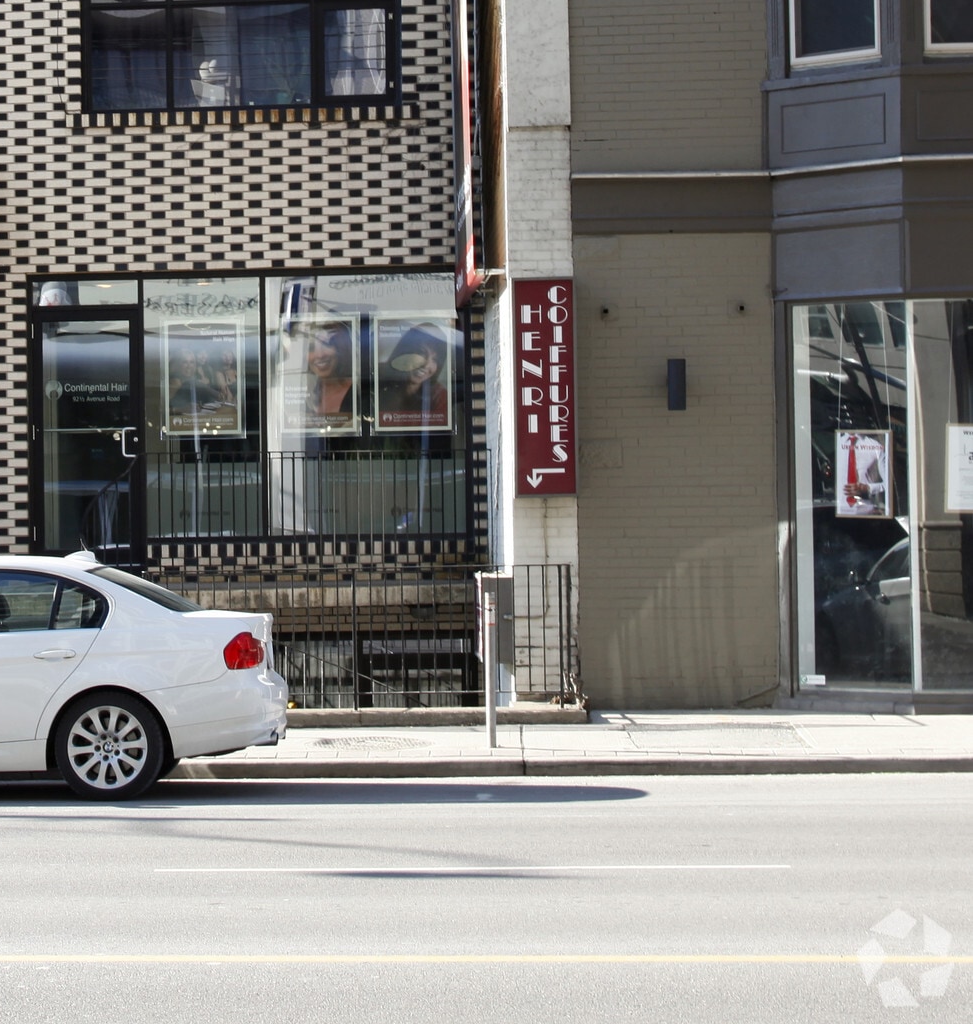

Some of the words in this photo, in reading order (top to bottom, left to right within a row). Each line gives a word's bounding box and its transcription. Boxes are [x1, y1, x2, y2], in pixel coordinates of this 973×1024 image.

[64, 383, 108, 393] Continental
[111, 382, 127, 392] Hair
[521, 304, 543, 433] HENRI
[547, 285, 570, 463] COIFFURES
